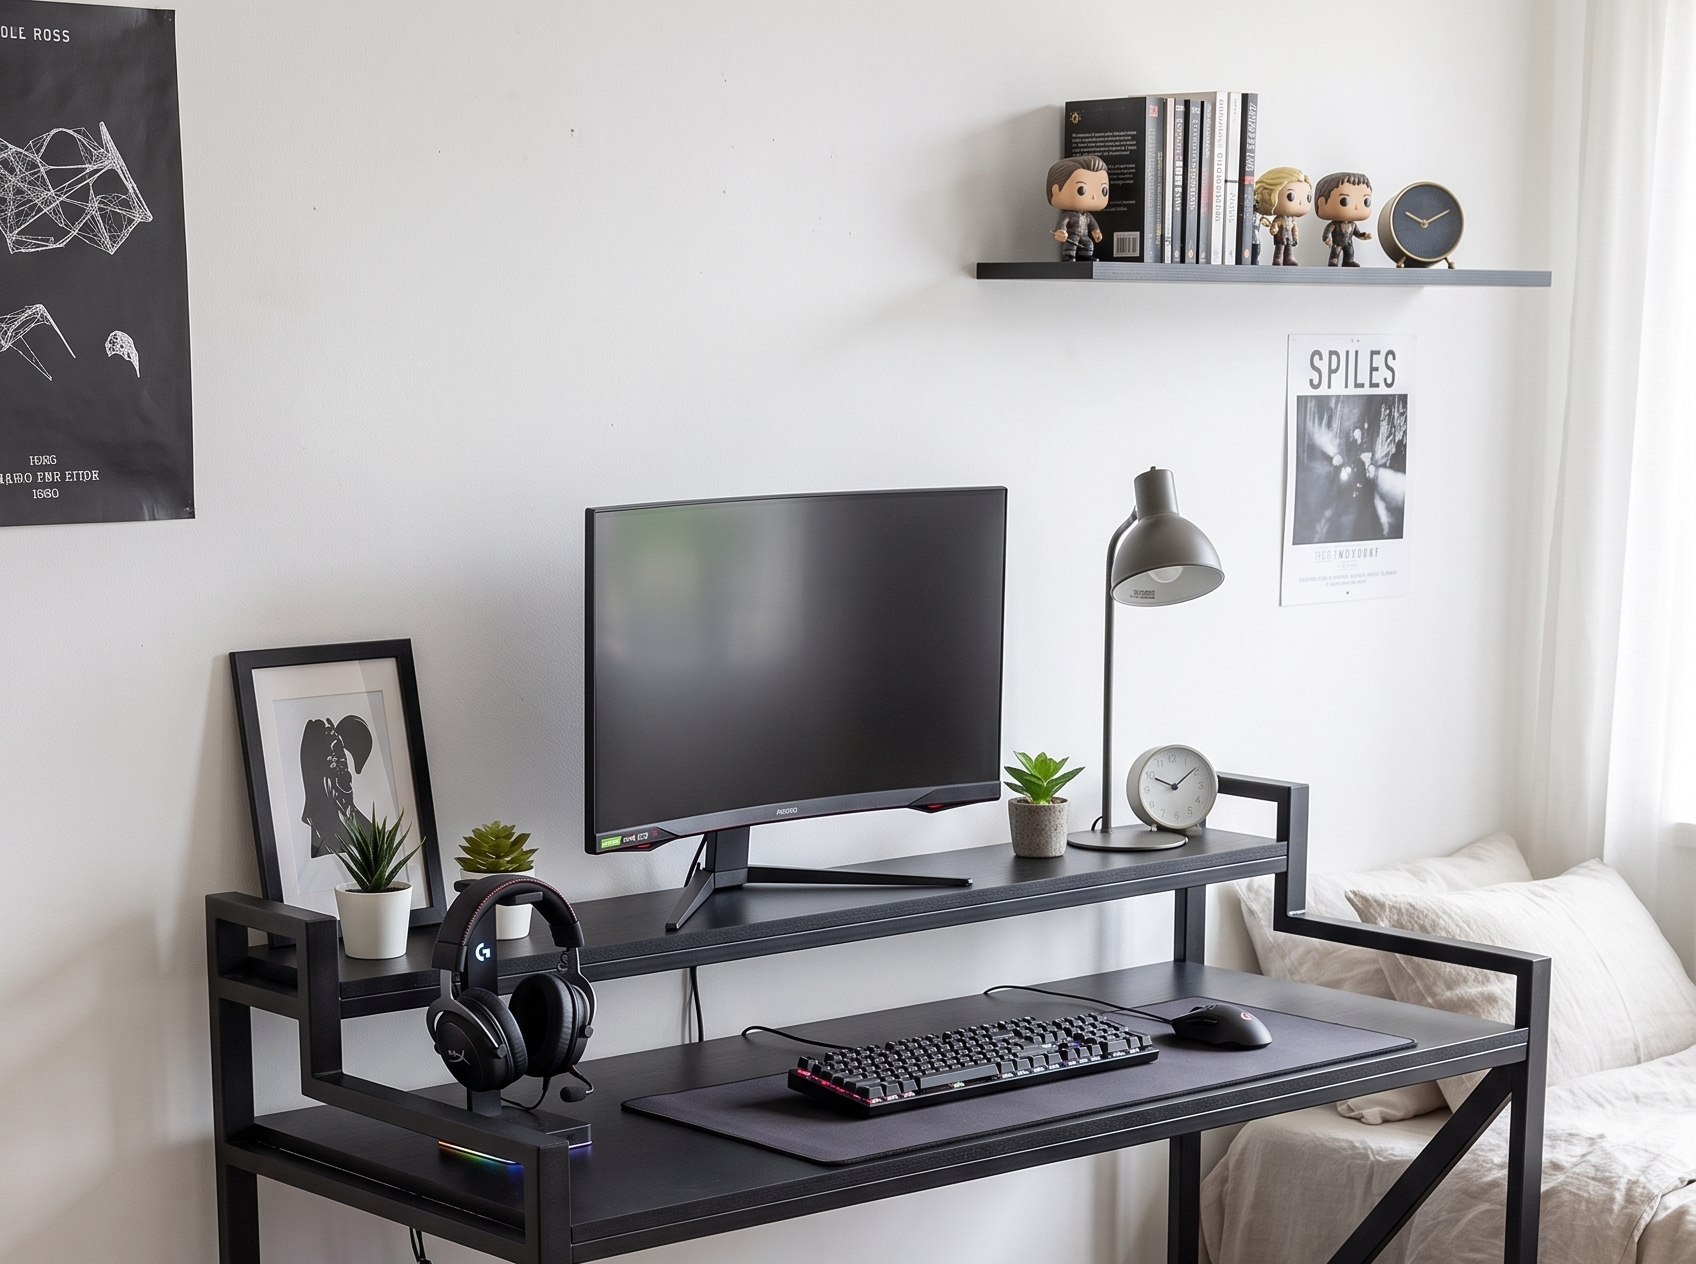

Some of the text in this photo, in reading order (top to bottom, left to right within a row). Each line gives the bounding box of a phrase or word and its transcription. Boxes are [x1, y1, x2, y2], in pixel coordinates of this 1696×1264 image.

[1, 25, 70, 42] OLE ROSS
[1309, 349, 1396, 390] SPILES
[1146, 771, 1156, 780] 10
